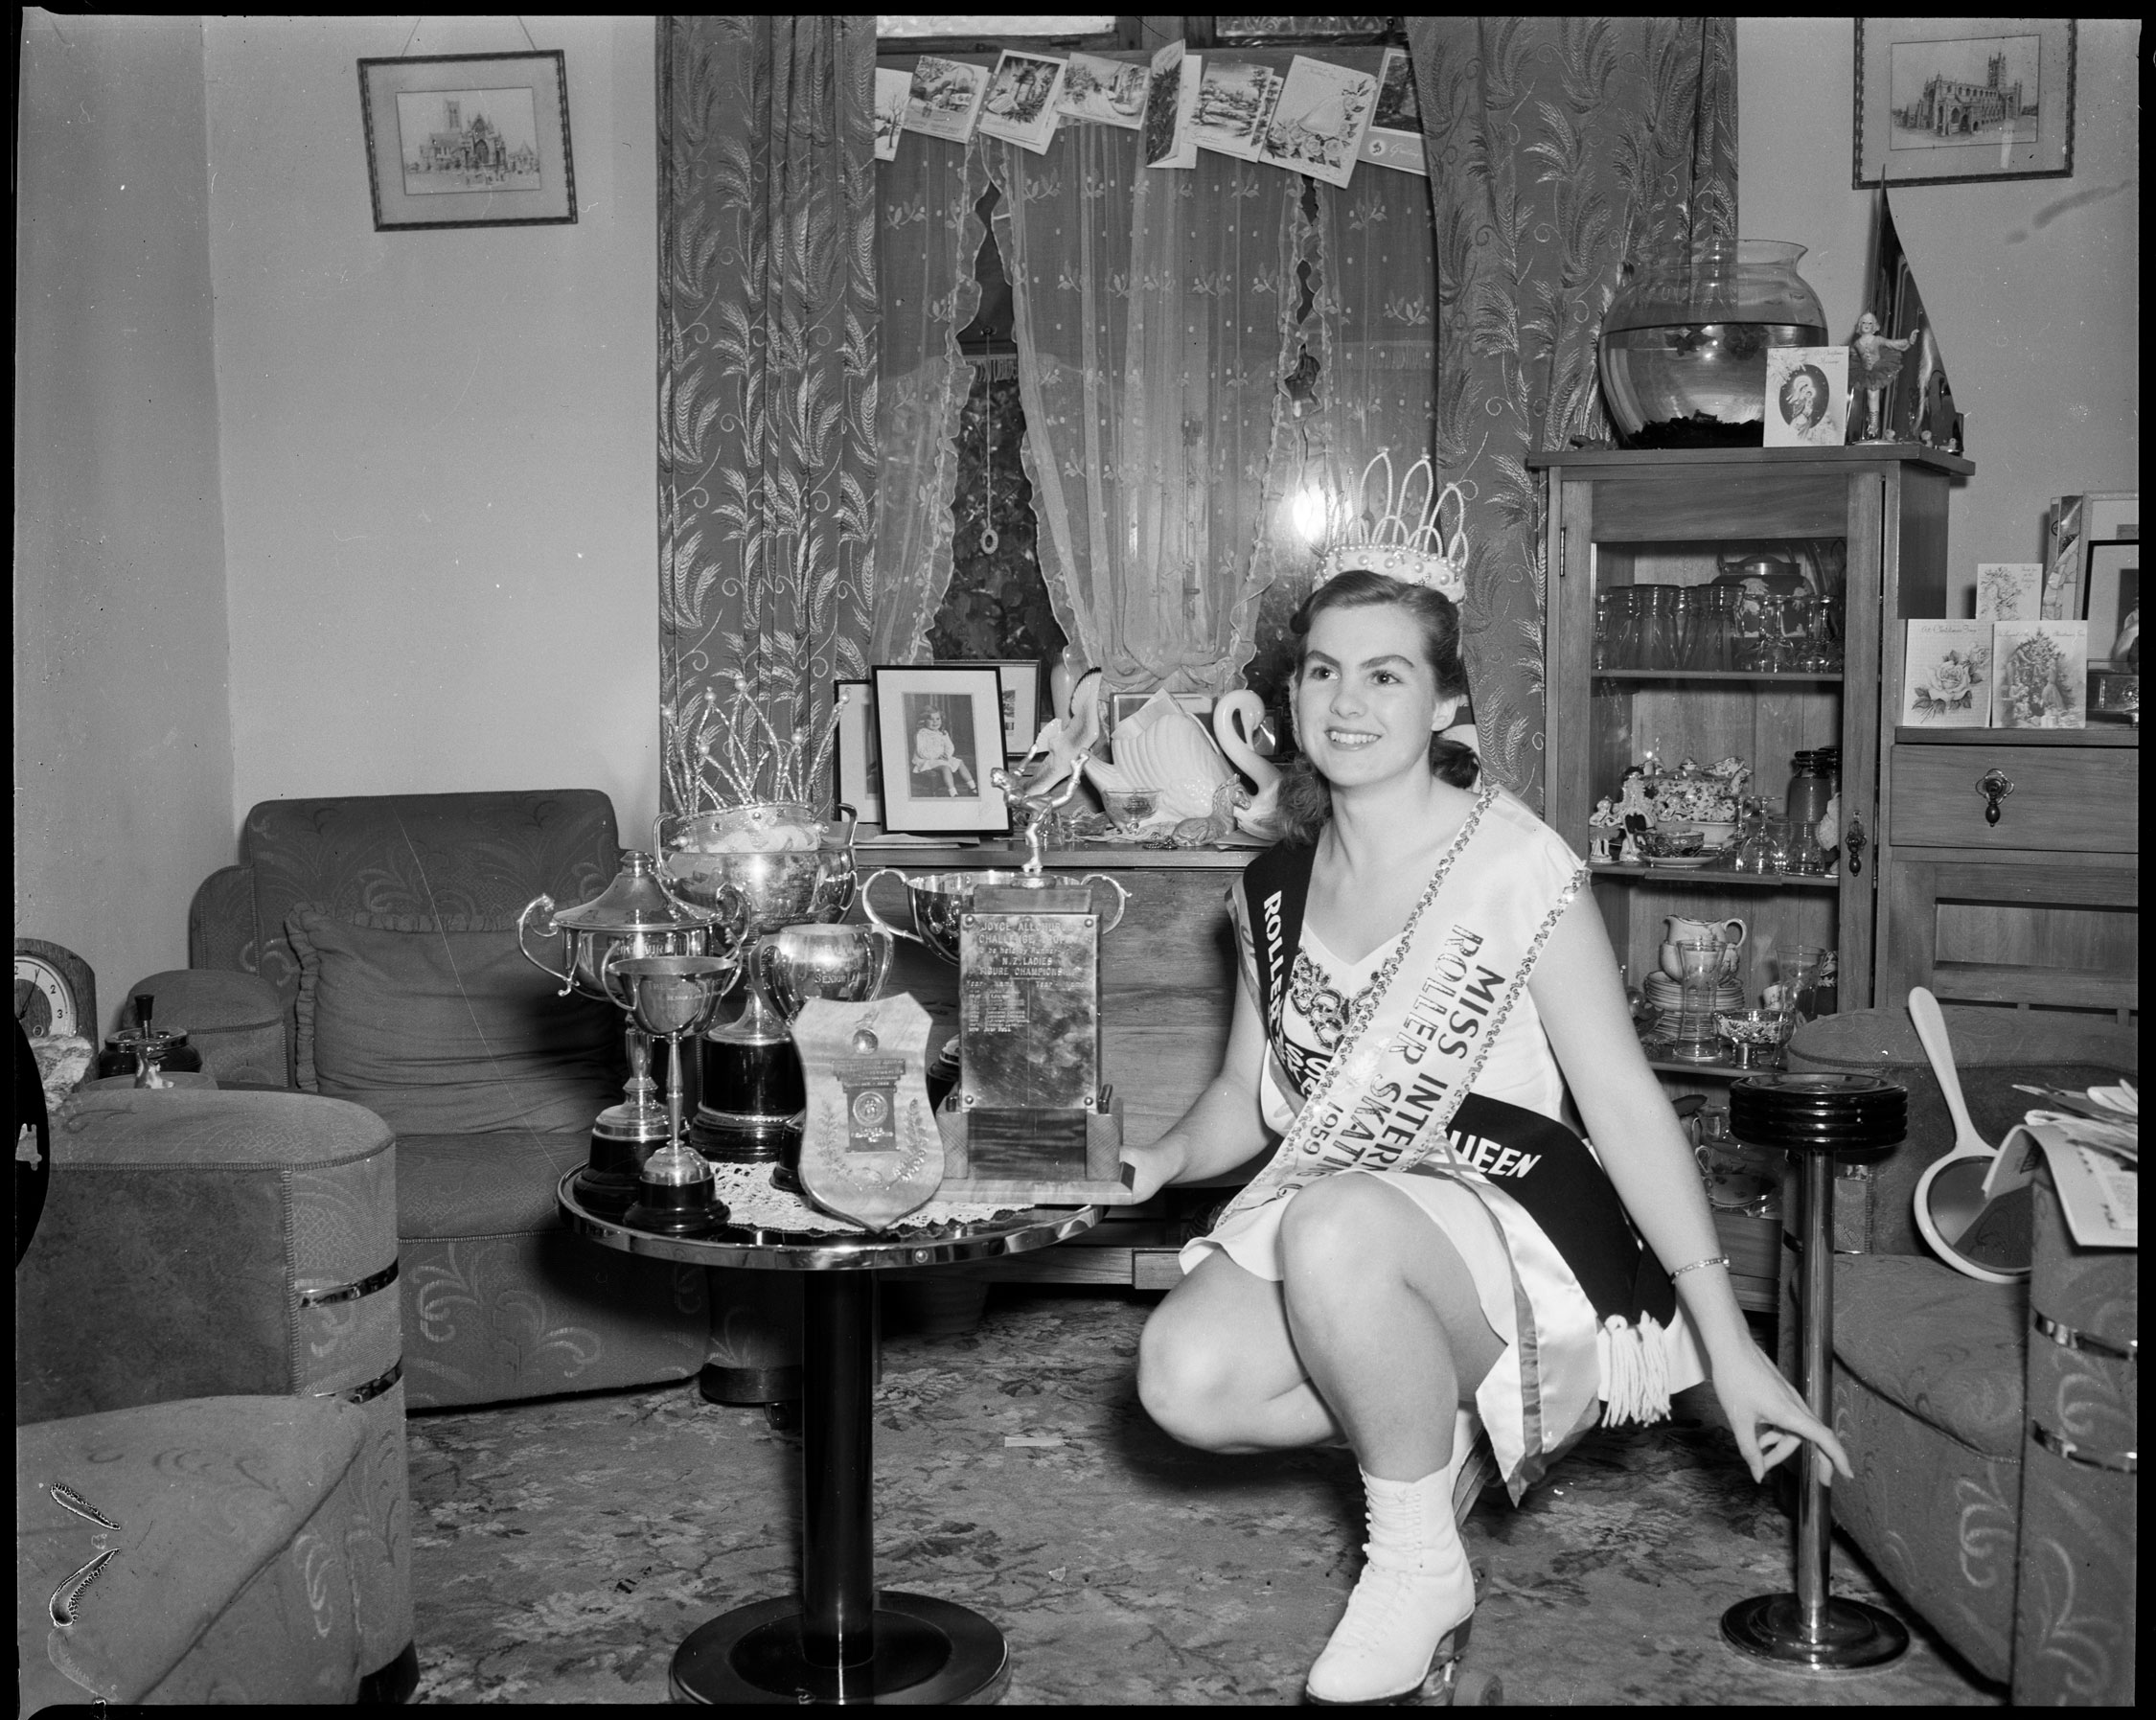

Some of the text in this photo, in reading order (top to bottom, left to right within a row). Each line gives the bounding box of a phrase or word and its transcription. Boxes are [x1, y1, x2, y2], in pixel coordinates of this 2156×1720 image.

[50, 984, 57, 995] 2
[57, 1009, 63, 1019] 3
[1388, 924, 1484, 1066] ROLLER
[1436, 964, 1506, 1060] MISS
[1303, 1101, 1343, 1156] 1959
